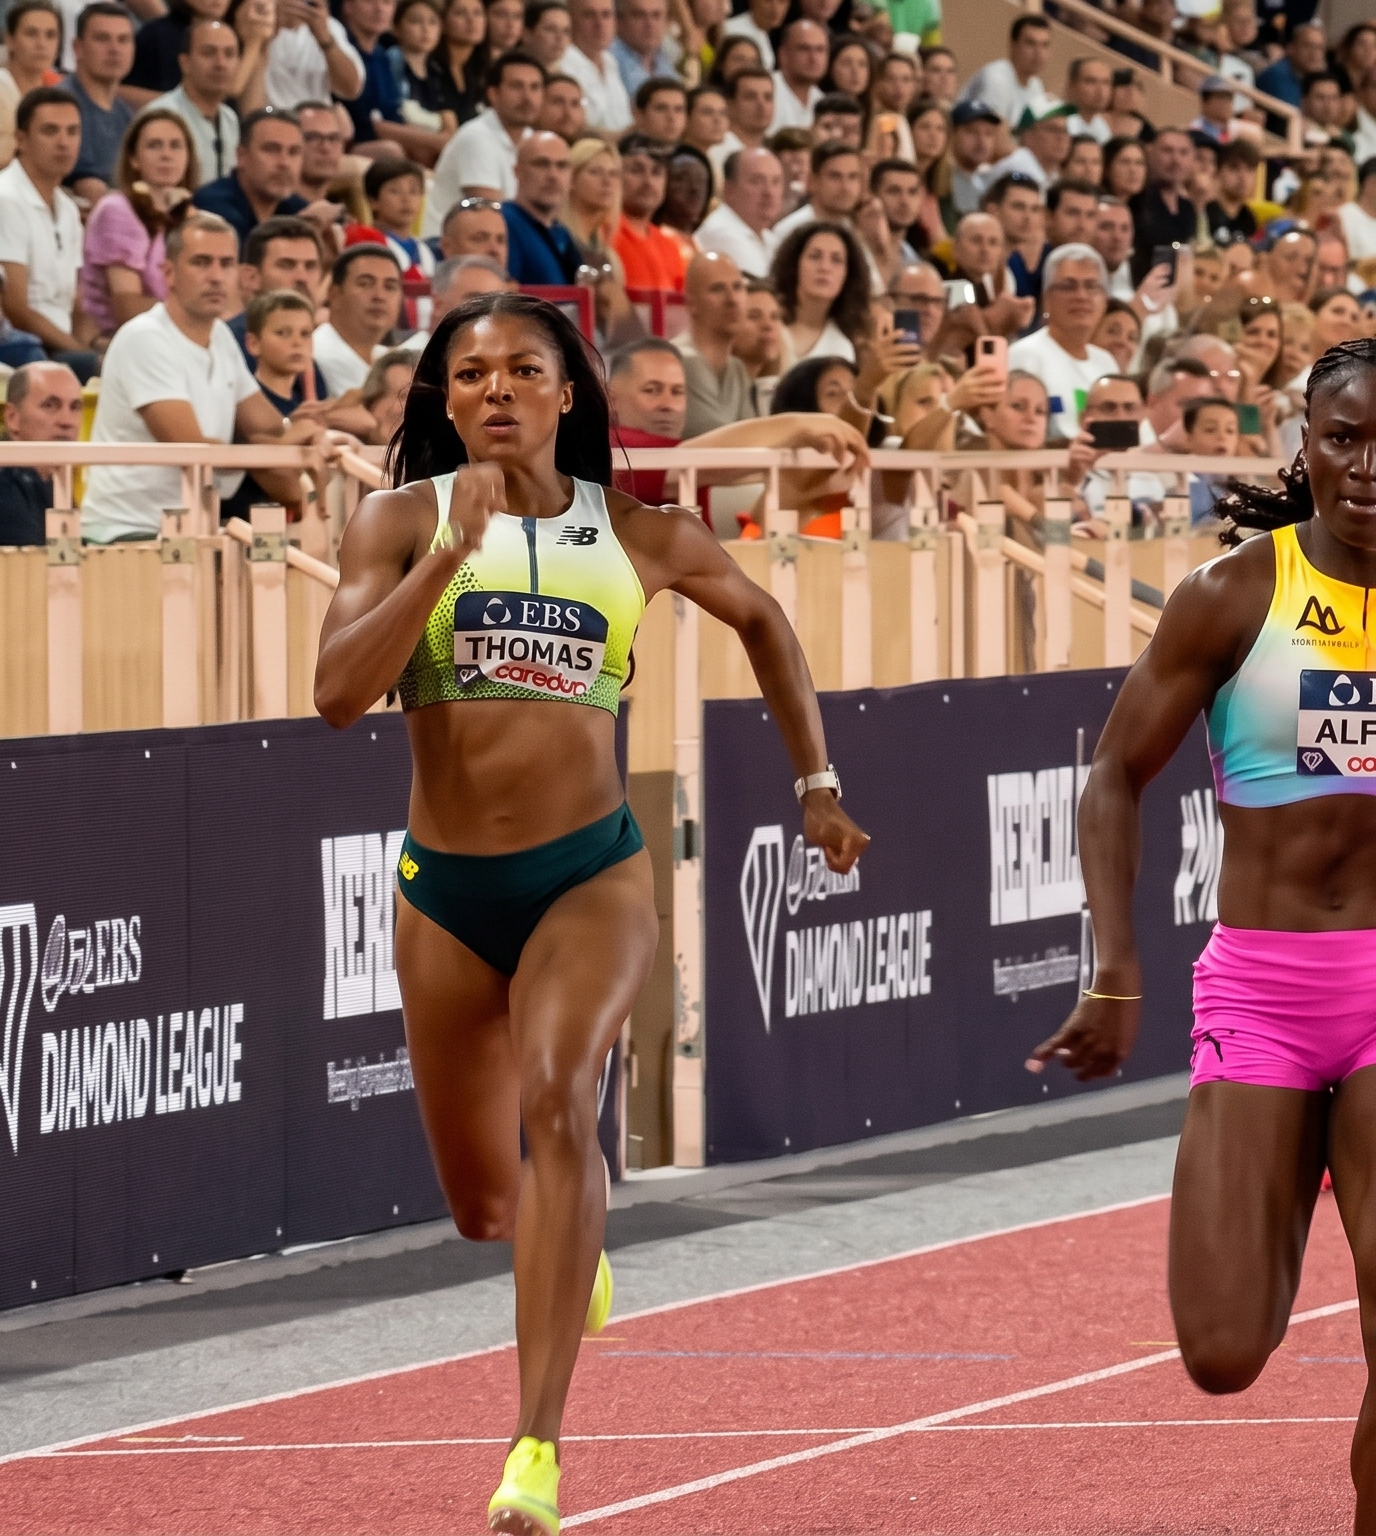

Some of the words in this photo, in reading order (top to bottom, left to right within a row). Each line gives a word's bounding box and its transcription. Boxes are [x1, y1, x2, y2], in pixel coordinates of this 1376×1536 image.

[519, 600, 581, 632] EBS
[465, 636, 593, 671] THOMAS
[94, 915, 142, 987] EBS
[785, 920, 865, 1018] DIAMOND
[866, 909, 932, 1004] LEAGUE
[40, 1018, 150, 1135] DIAMOND
[155, 1002, 244, 1115] LEAGUE
